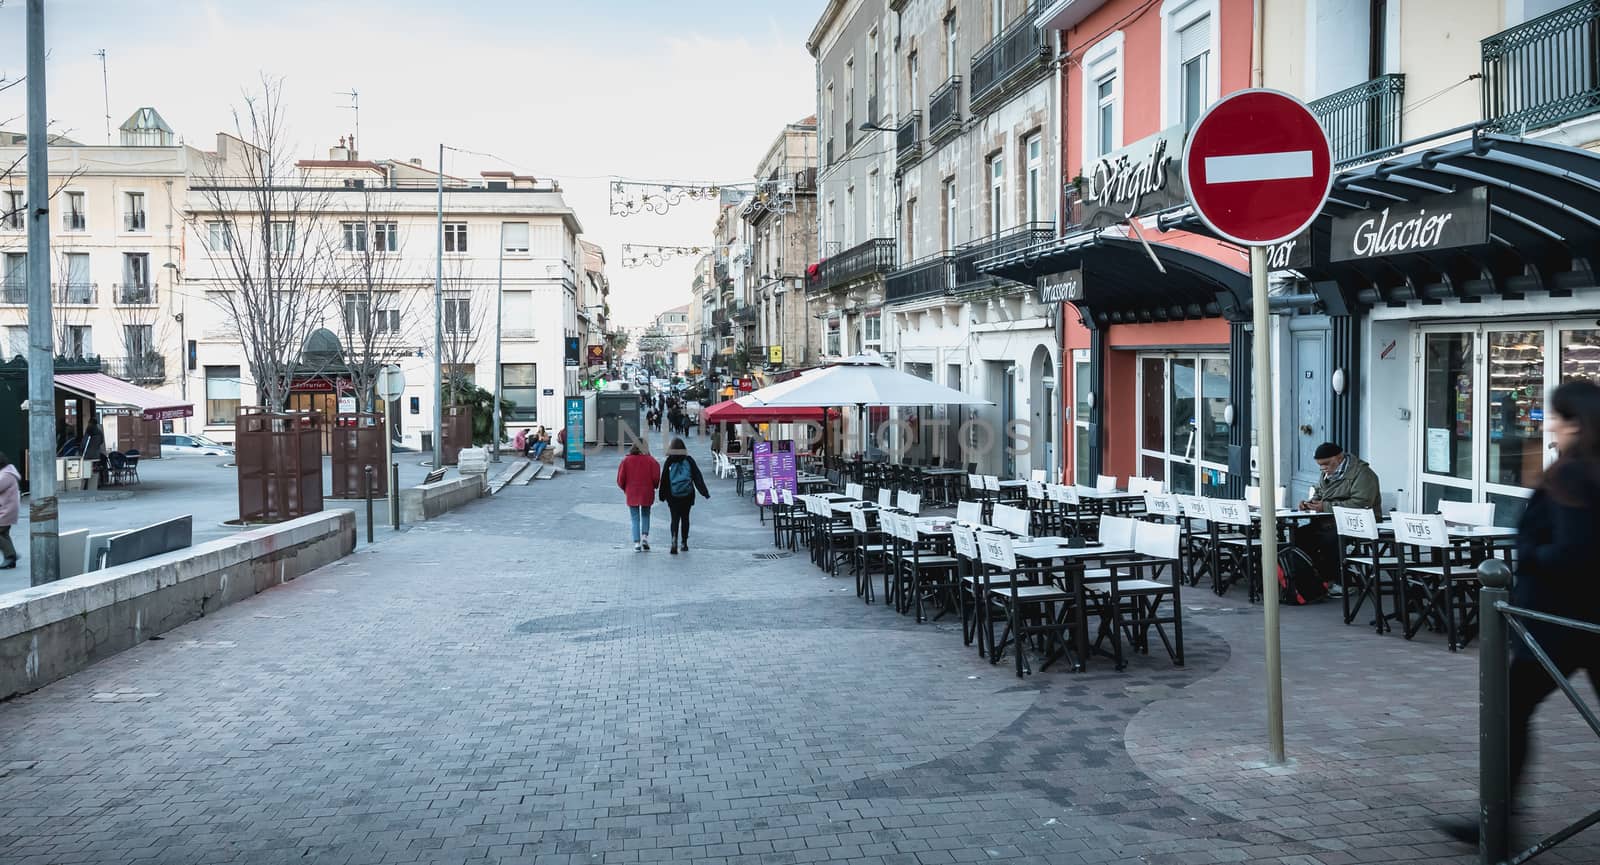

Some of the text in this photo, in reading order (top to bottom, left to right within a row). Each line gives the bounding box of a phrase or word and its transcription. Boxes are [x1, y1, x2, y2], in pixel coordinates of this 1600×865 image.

[1089, 138, 1168, 219] Virgil's
[1353, 207, 1452, 257] Glacier
[1042, 276, 1077, 303] brasserie
[1345, 513, 1365, 530] Virgil's
[1406, 519, 1431, 537] Virgil's
